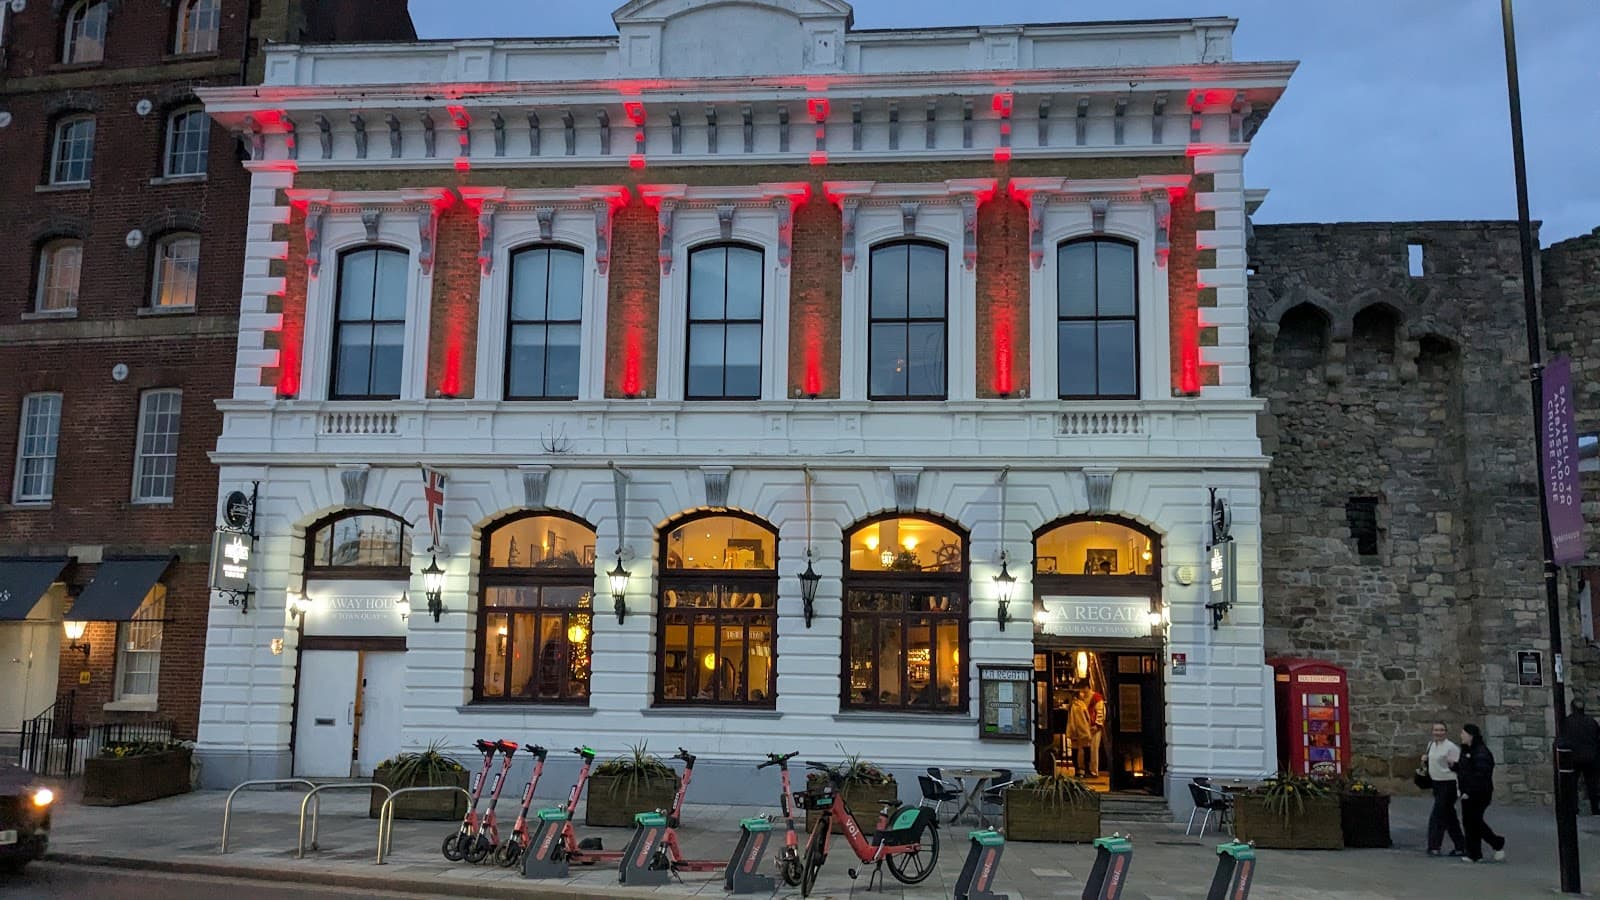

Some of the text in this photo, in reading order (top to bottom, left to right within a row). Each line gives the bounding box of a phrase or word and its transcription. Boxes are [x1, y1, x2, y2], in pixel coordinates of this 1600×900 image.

[1548, 400, 1558, 502] CRUISE LINE
[1553, 393, 1565, 505] AMBASSADOR
[1559, 385, 1572, 506] SAY HELLO TO
[366, 598, 399, 609] HOUS
[1075, 606, 1147, 621] REGATA
